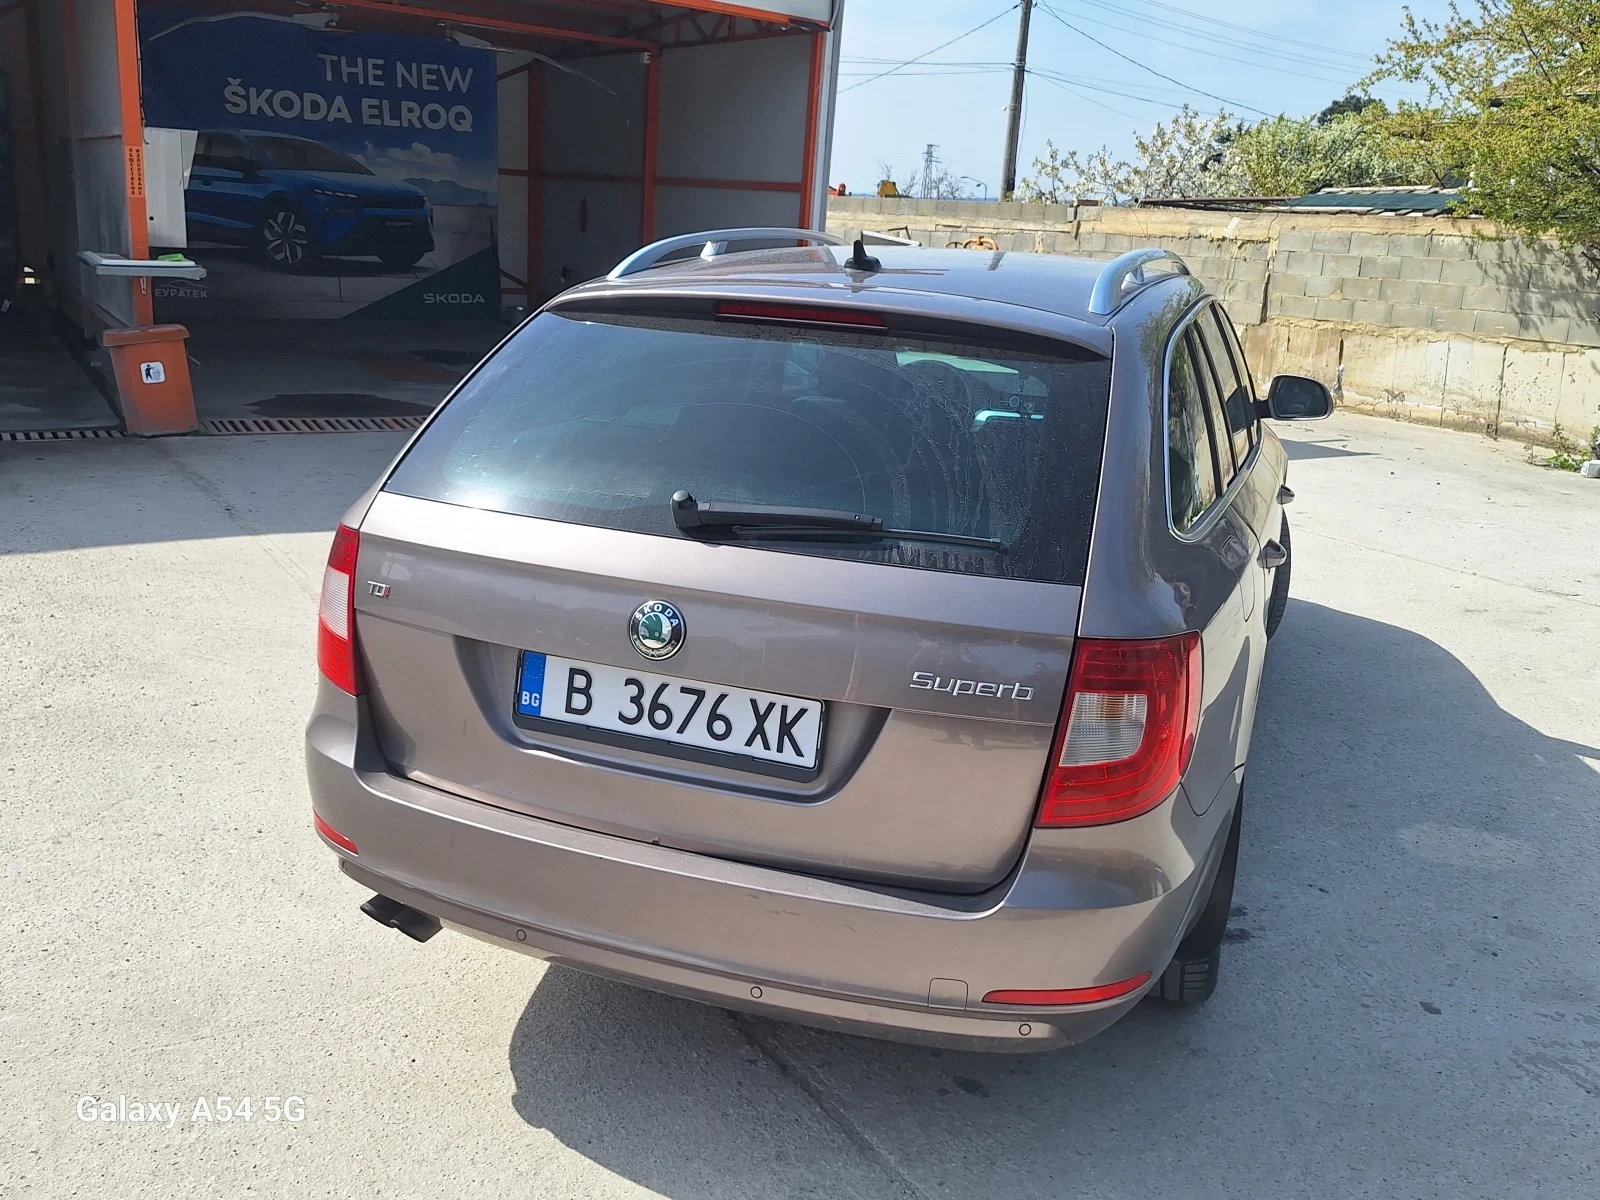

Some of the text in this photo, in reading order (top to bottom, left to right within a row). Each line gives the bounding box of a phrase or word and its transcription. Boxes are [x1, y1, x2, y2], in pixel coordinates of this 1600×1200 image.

[317, 53, 474, 94] THE NEW
[223, 77, 474, 133] ŠKODA ELROQ
[521, 690, 541, 708] BG
[909, 671, 1035, 701] Superb
[565, 667, 809, 759] B 3676 XK
